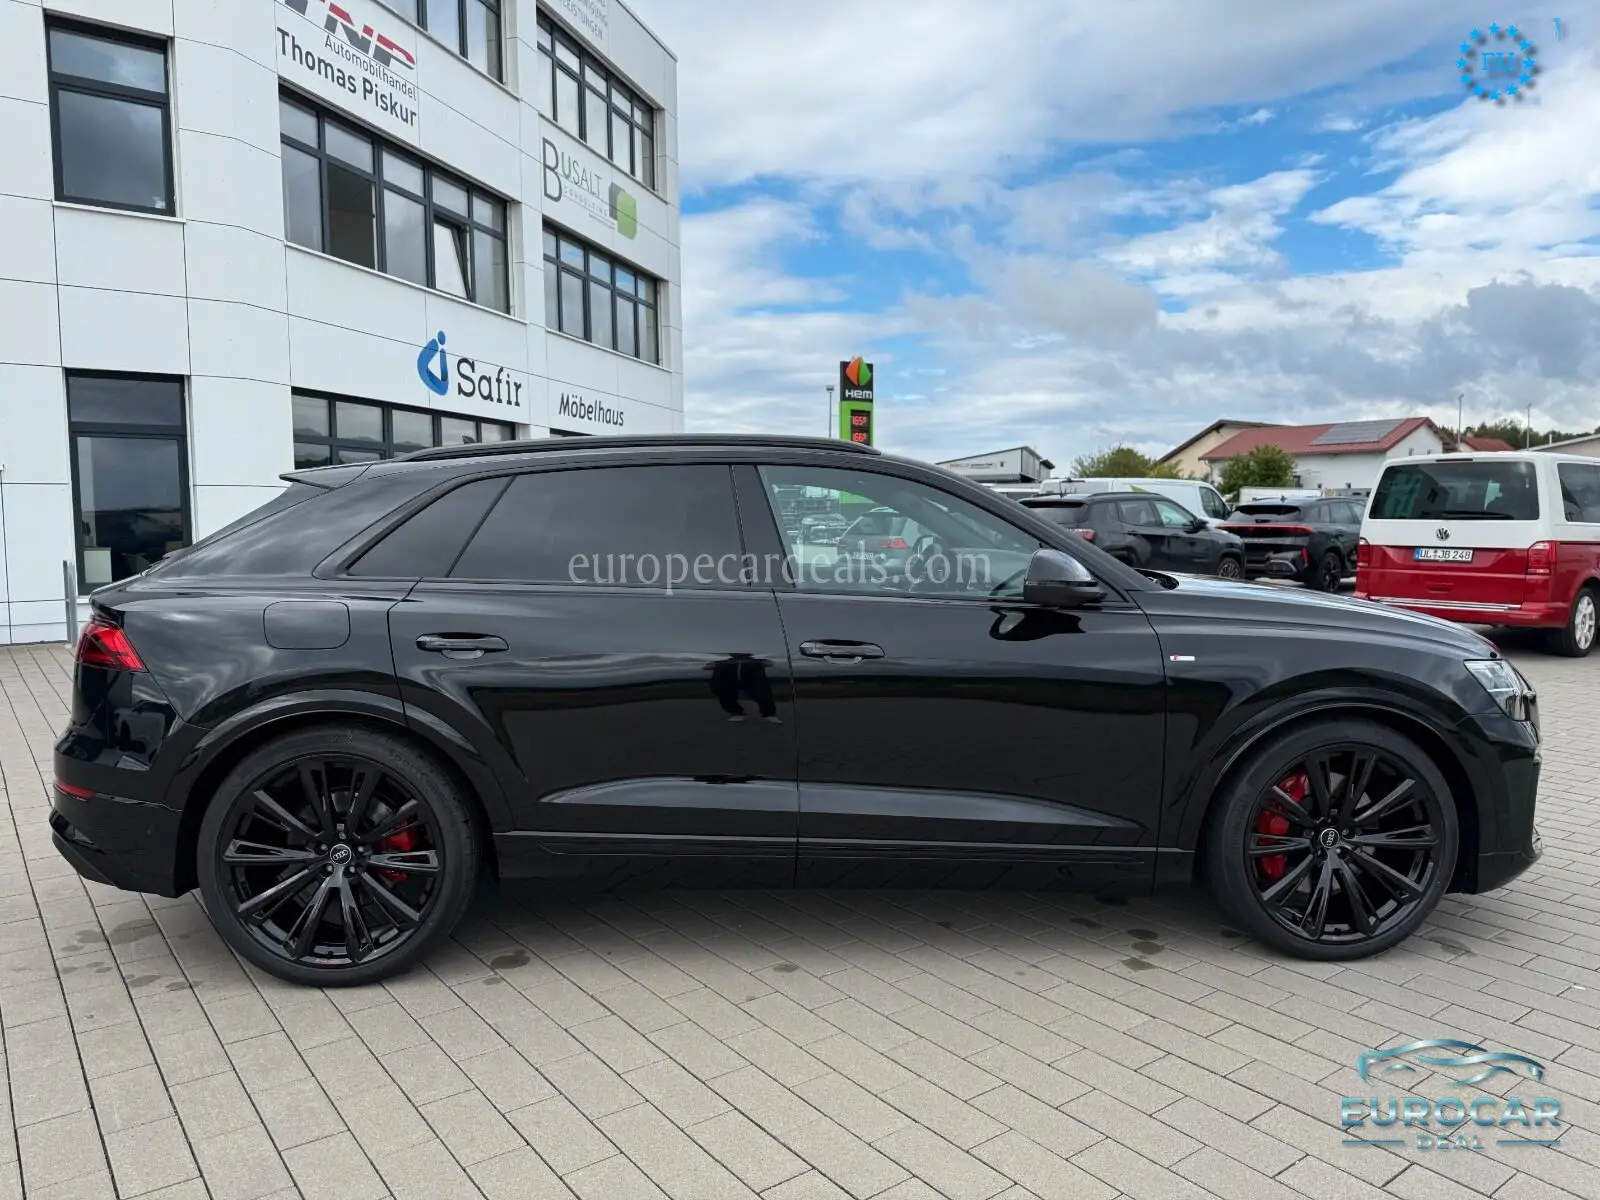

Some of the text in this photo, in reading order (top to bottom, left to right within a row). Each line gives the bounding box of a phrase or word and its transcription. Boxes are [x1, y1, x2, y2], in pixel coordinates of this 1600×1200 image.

[276, 26, 417, 126] Thomas Piskur
[325, 34, 417, 101] Automobilhandel
[542, 136, 602, 202] BUSALT
[456, 357, 522, 407] Safir
[559, 392, 625, 427] Möbelhaus
[1452, 551, 1471, 560] 248
